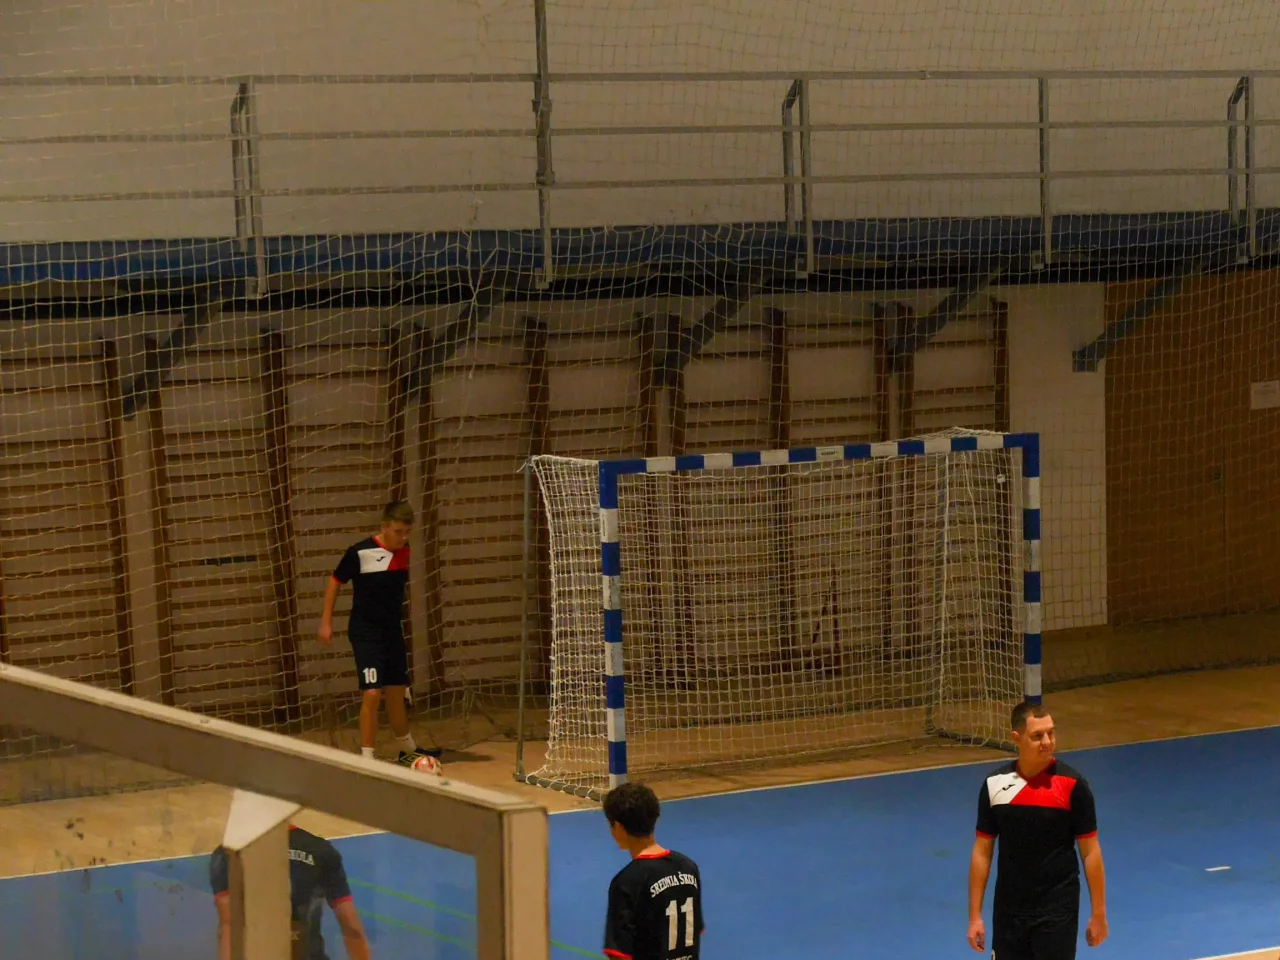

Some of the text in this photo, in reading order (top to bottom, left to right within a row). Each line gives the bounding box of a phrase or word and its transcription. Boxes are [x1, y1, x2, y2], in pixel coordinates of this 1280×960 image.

[362, 667, 378, 684] 10
[650, 875, 680, 898] SREDNJA
[665, 897, 694, 951] 11
